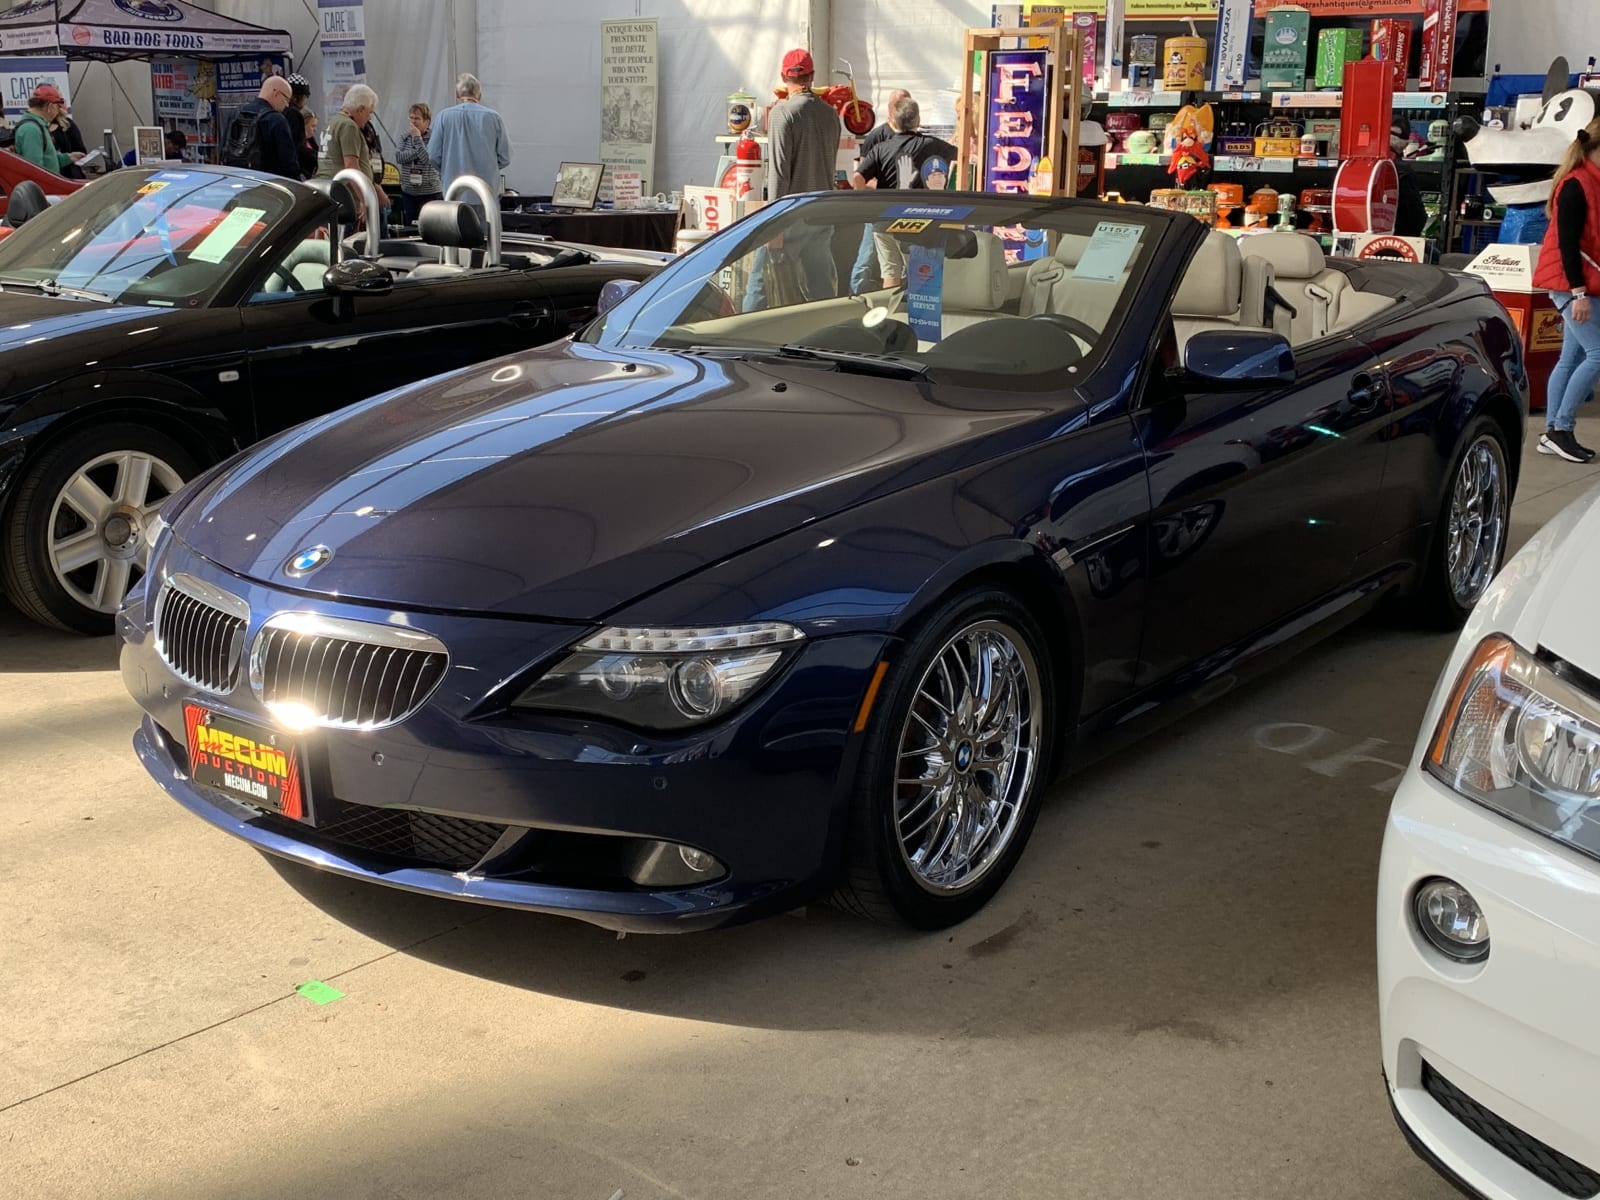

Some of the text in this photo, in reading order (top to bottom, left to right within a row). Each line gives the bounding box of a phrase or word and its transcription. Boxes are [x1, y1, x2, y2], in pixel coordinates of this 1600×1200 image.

[324, 11, 346, 33] CARE
[606, 24, 654, 34] ANTIQUE SAFES
[1222, 8, 1232, 53] VIAGRA
[103, 29, 204, 49] BAD DOG TOOLS
[610, 35, 648, 43] FRUSTRATE
[611, 45, 646, 54] THE DEVIL
[603, 56, 617, 64] OUT
[627, 56, 653, 64] PEOPLE
[612, 66, 646, 74] WHO WANT
[608, 76, 624, 84] YOUR
[10, 77, 40, 99] CAR
[892, 221, 925, 230] NR
[1369, 240, 1409, 253] WYNN'S
[1482, 254, 1520, 266] Indian
[909, 293, 940, 303] DETAILING
[912, 301, 936, 310] SERVICE
[197, 725, 288, 778] MECUM
[199, 753, 290, 792] AUCTIONS
[224, 772, 268, 800] MECUM.COM
